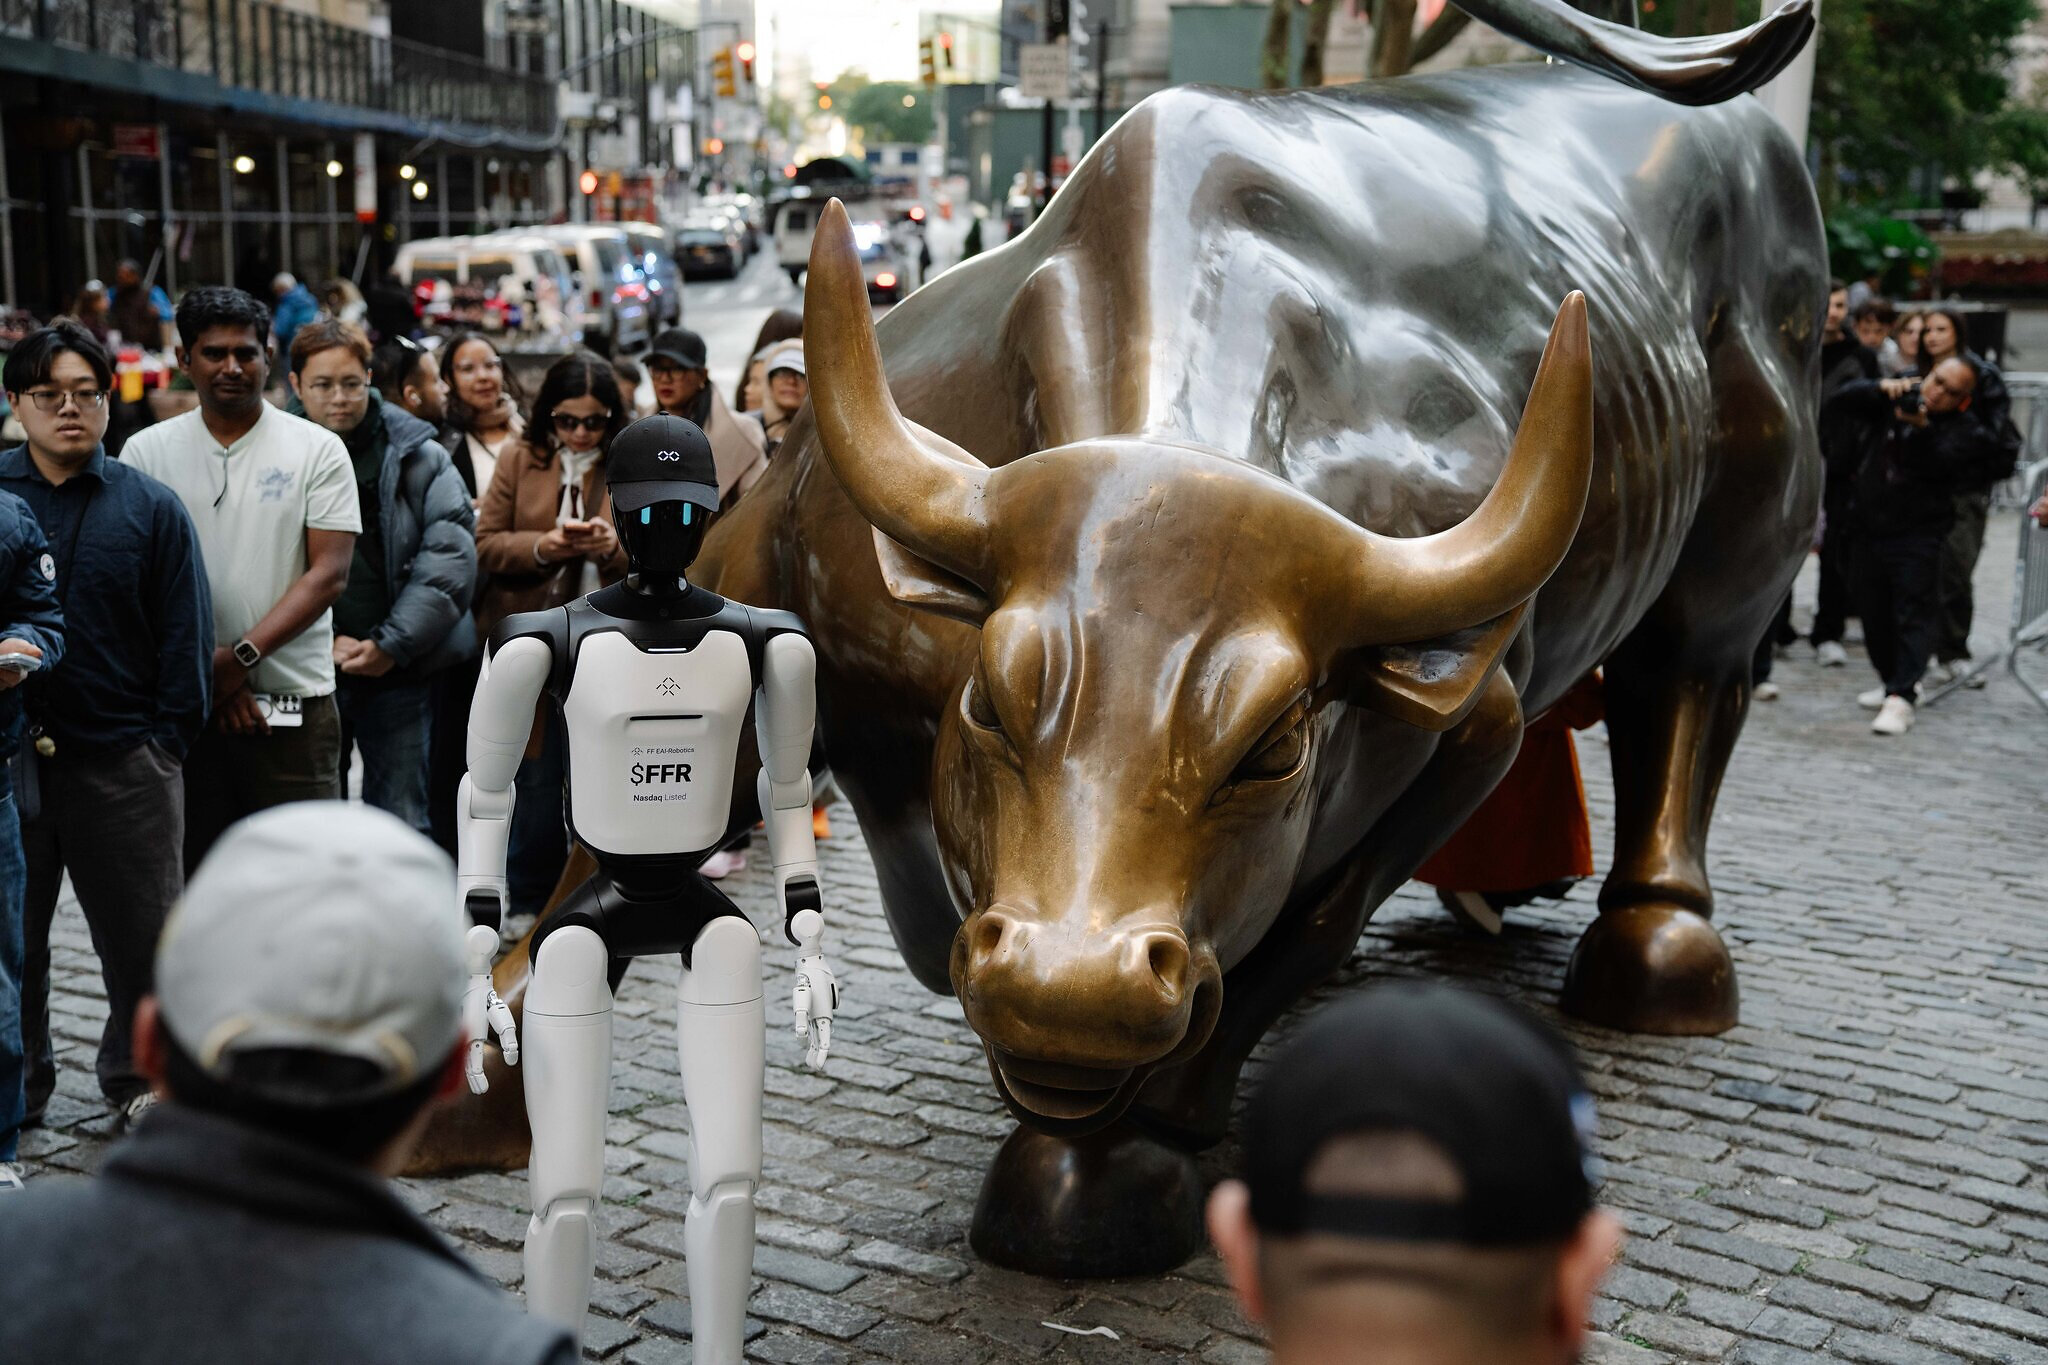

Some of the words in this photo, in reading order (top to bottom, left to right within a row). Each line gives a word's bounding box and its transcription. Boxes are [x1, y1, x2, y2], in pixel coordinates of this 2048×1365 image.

[630, 761, 692, 787] $FFR
[633, 794, 663, 803] Nasdaq
[664, 792, 687, 801] Listed
